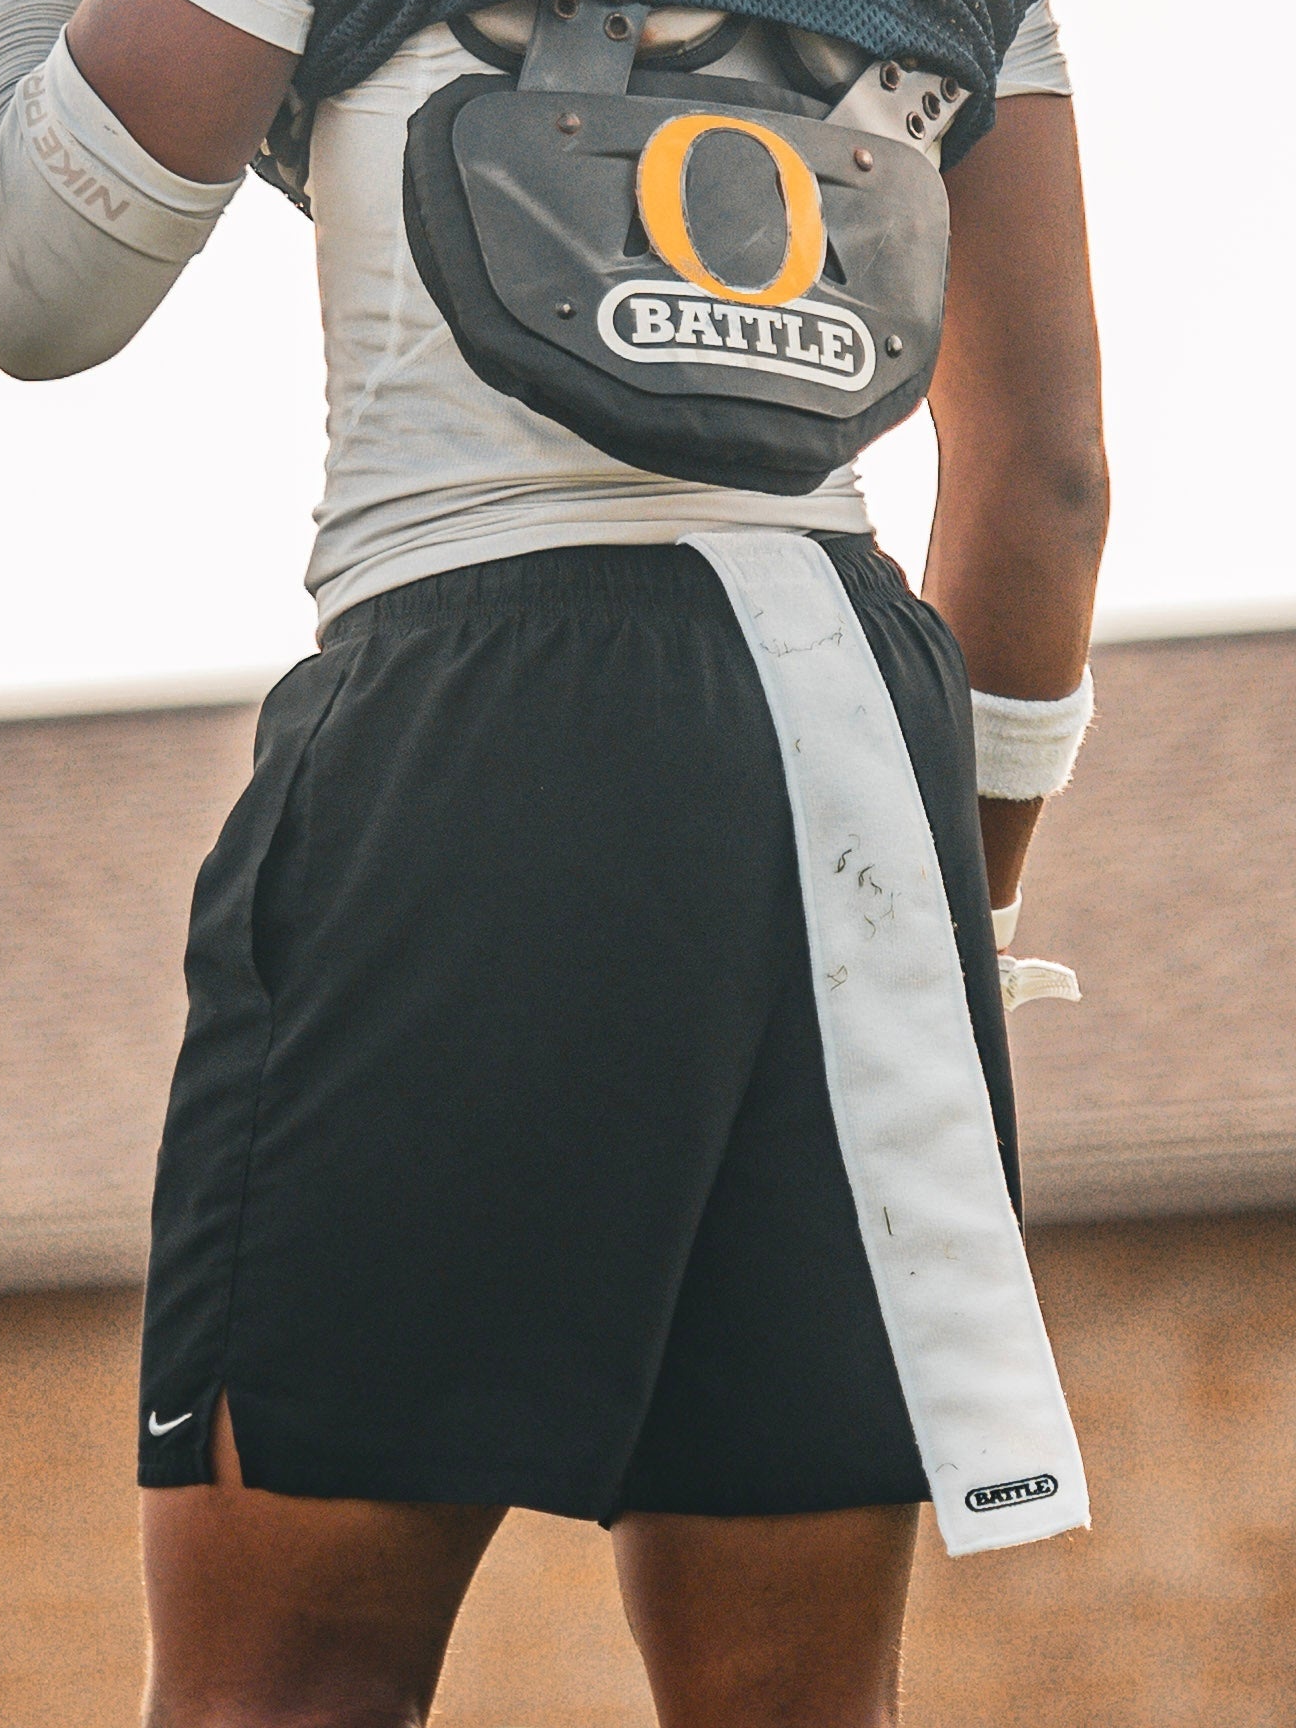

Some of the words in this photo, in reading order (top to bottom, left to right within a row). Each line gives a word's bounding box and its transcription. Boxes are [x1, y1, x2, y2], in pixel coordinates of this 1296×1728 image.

[22, 73, 48, 129] PR
[31, 125, 130, 222] NIKE
[636, 110, 827, 307] O
[630, 296, 855, 374] BATTLE
[973, 1477, 1051, 1507] BATTLE
